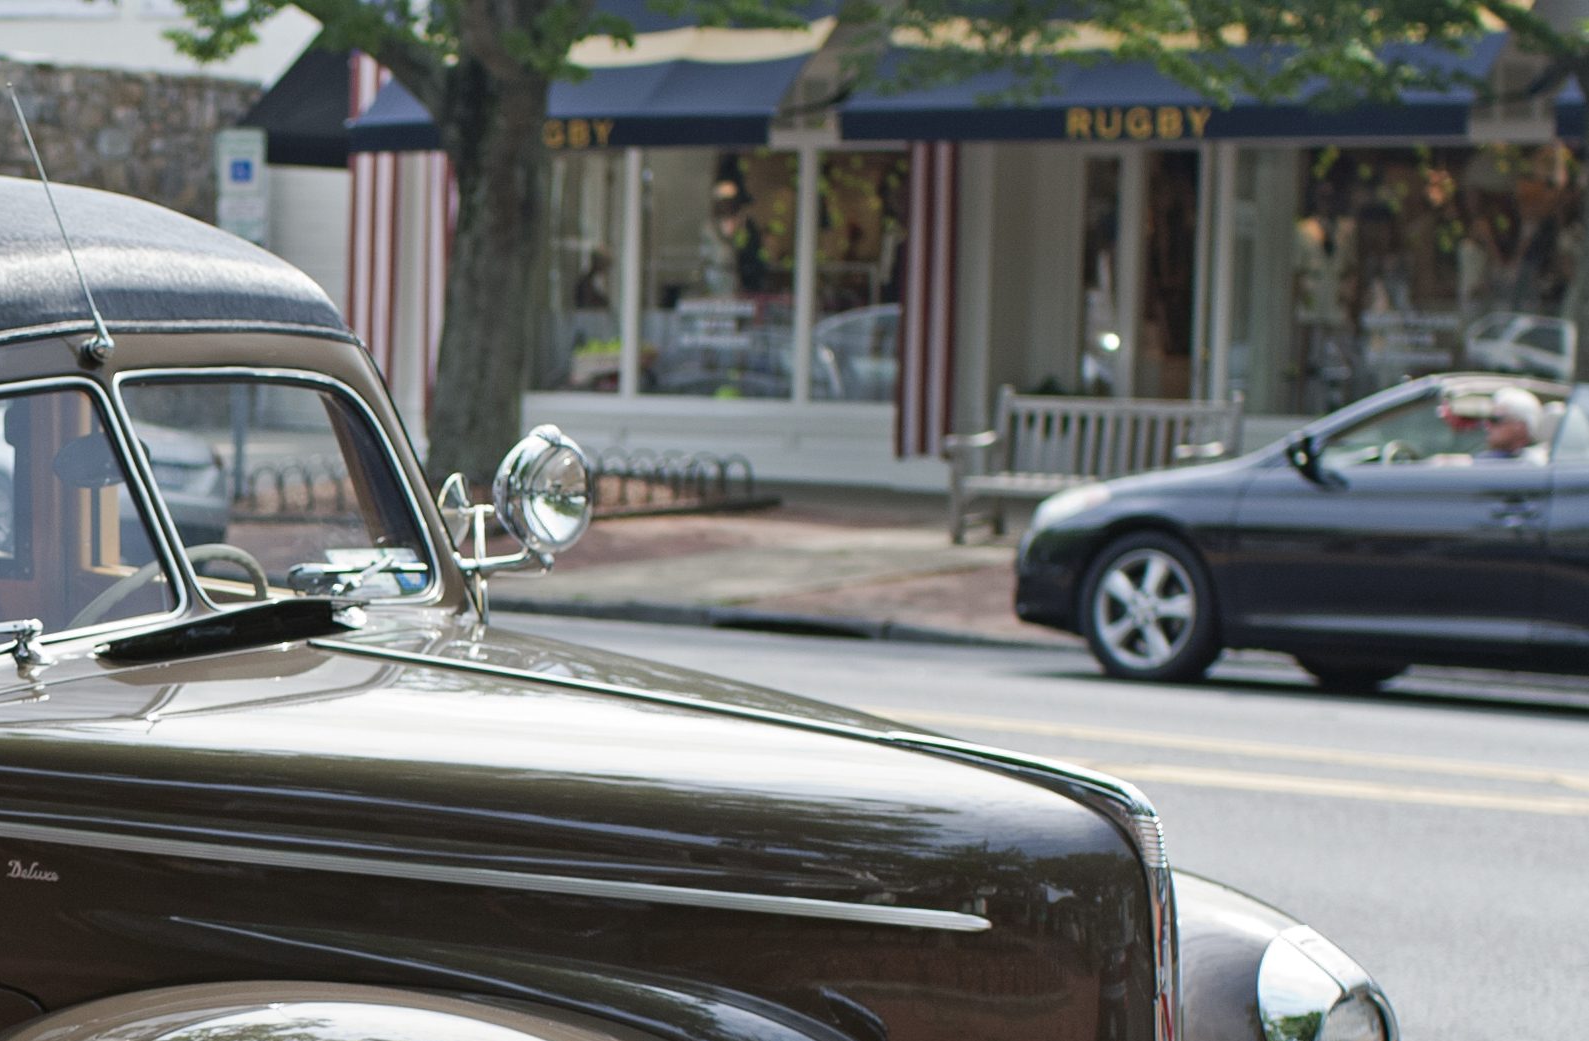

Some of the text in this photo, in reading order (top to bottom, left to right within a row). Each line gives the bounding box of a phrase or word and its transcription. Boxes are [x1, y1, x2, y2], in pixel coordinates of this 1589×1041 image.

[543, 119, 614, 148] GBY
[1067, 106, 1211, 139] RUGBY
[7, 859, 60, 882] Deluxe
